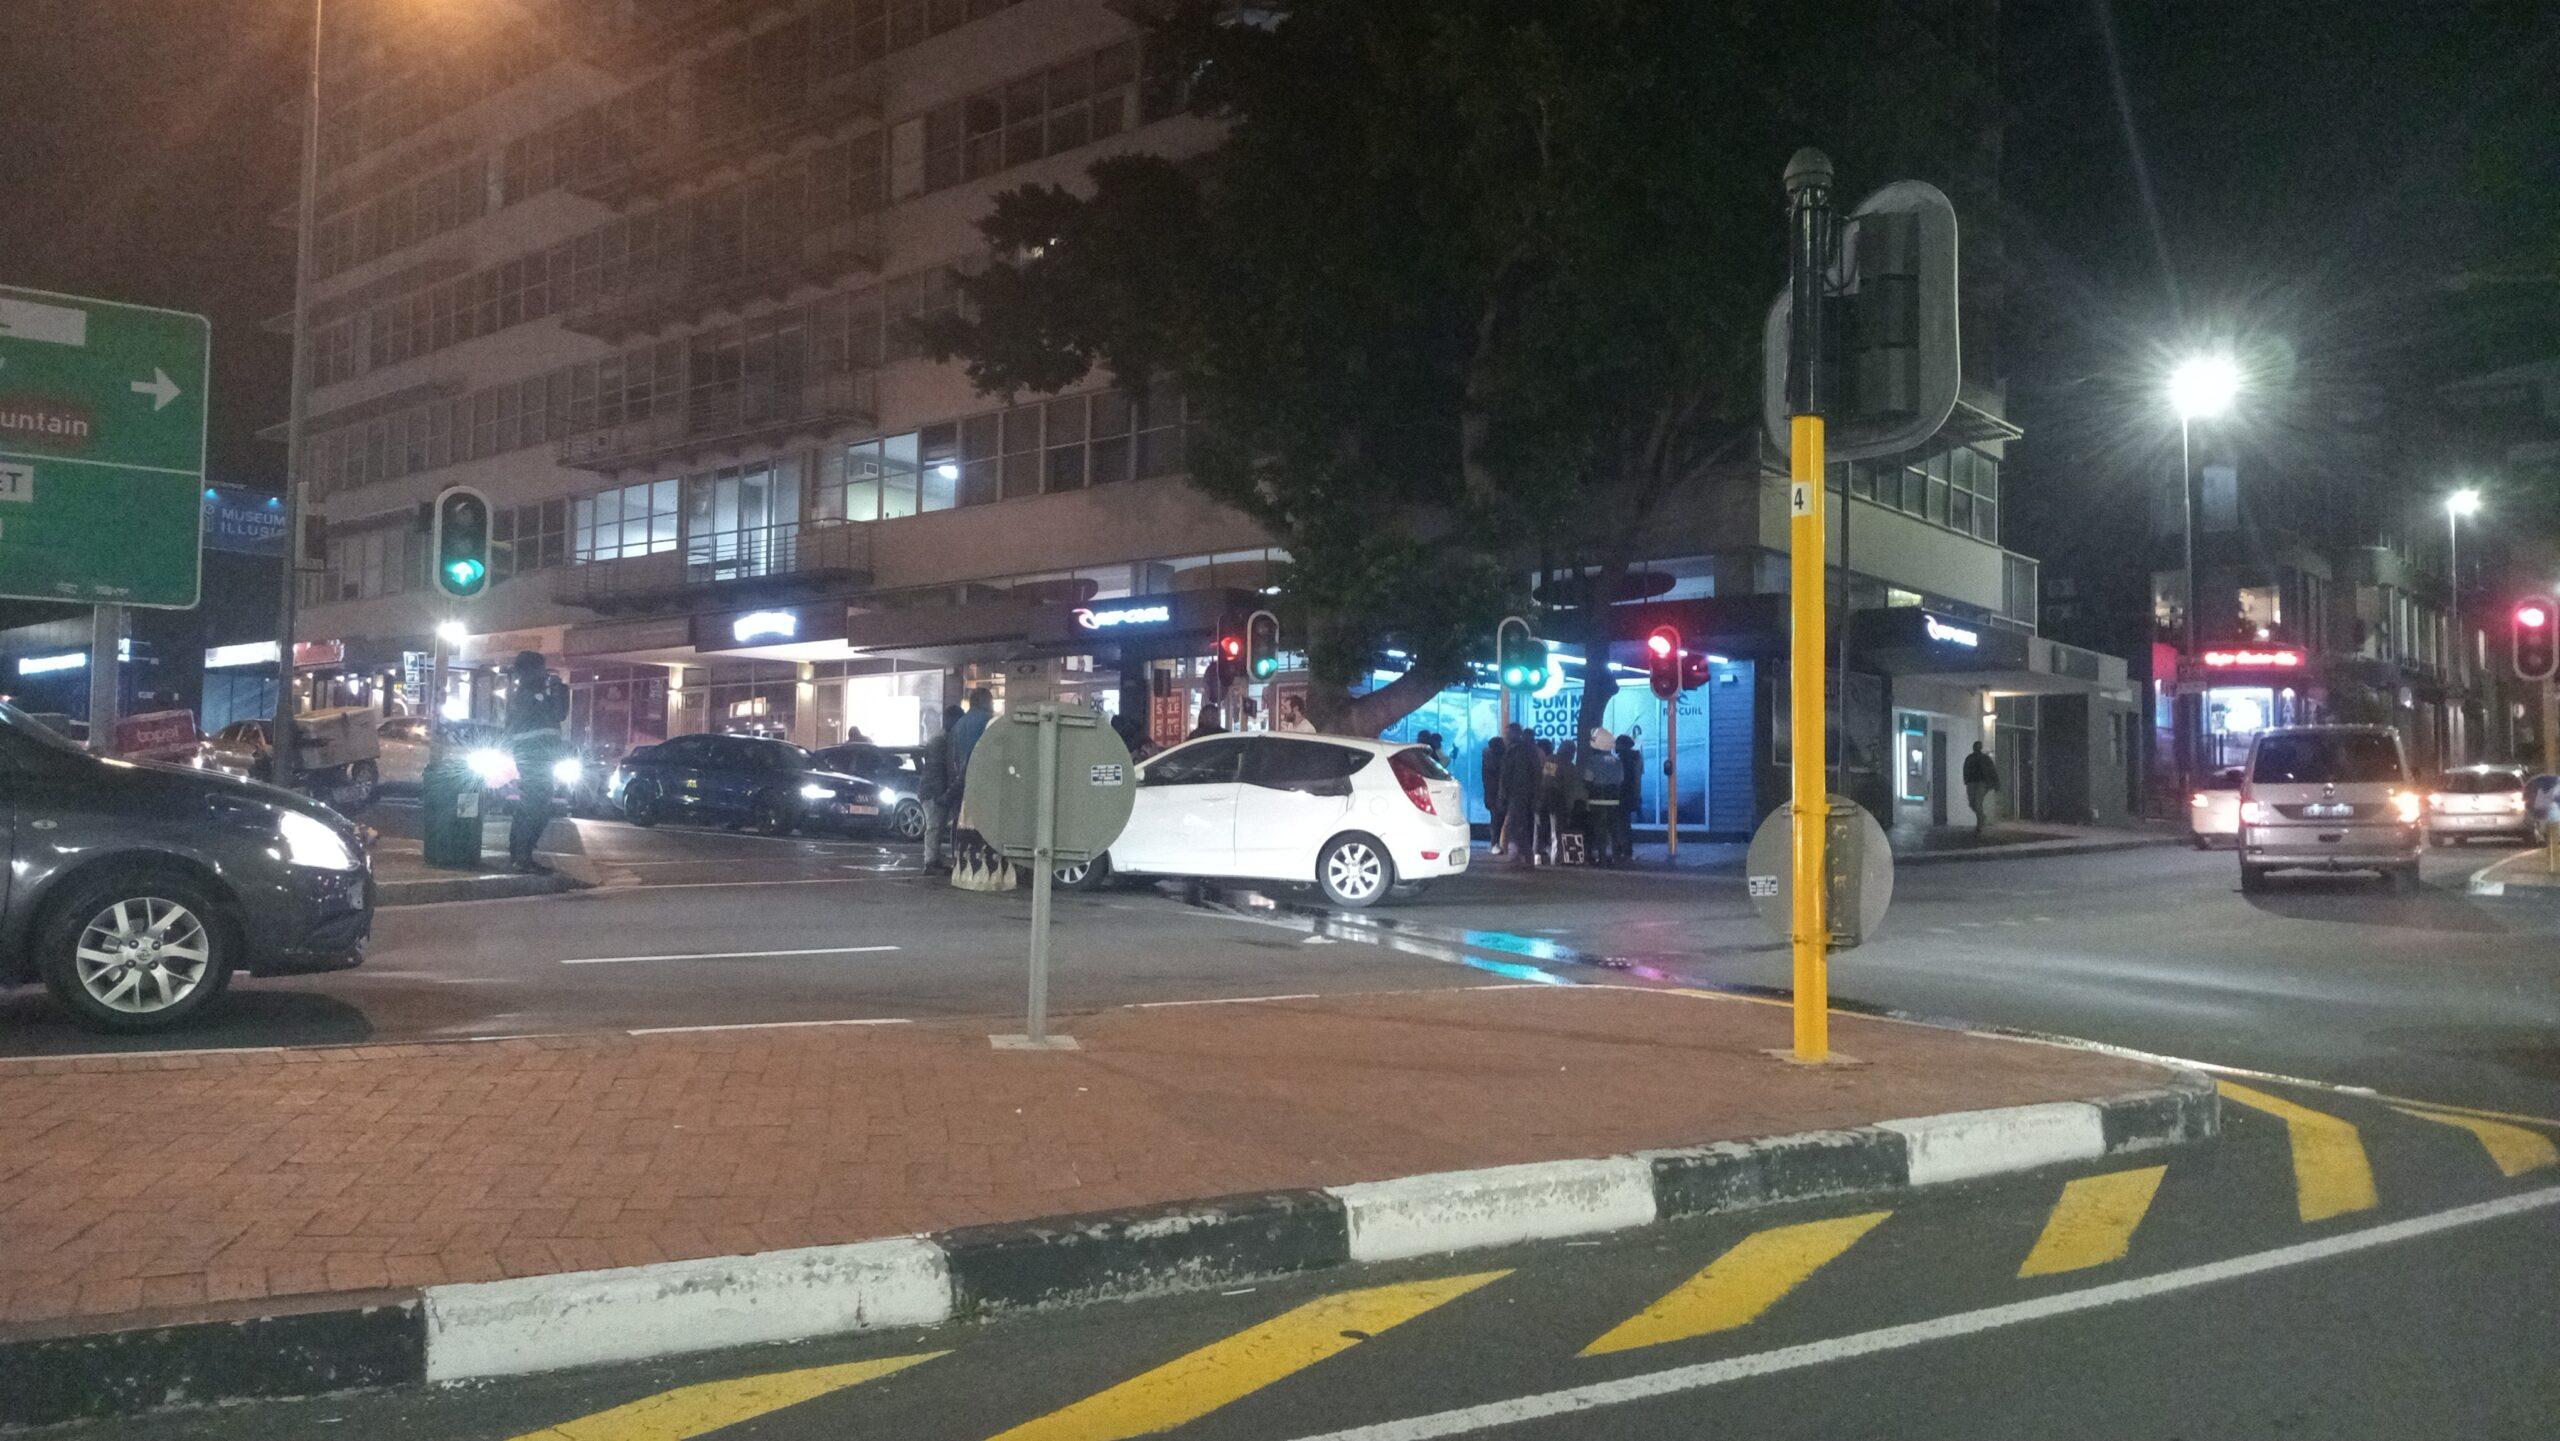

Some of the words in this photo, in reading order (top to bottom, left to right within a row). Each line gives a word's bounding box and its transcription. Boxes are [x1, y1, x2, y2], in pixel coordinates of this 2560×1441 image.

[1794, 487, 1804, 510] 4
[221, 508, 286, 527] MUSEUM
[1155, 702, 1181, 715] SLE
[1532, 695, 1584, 710] SUMM
[1155, 724, 1181, 737] SLE
